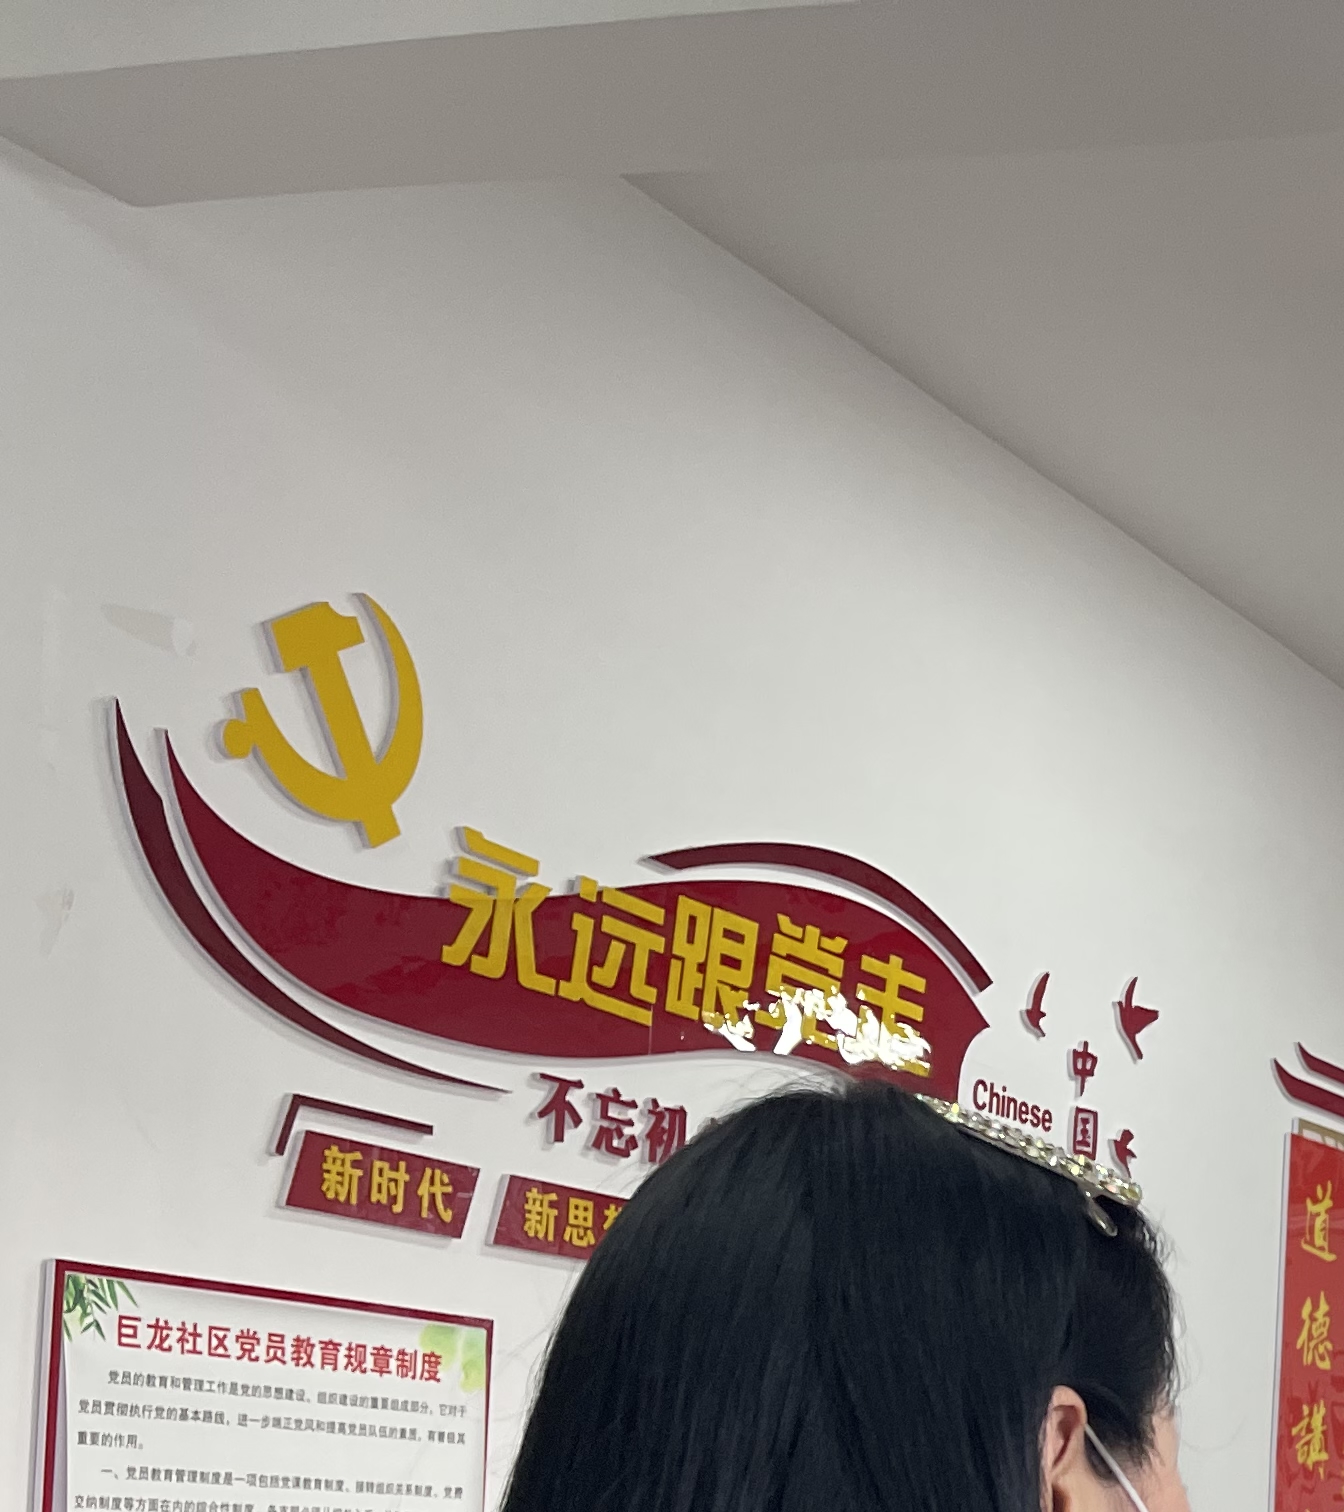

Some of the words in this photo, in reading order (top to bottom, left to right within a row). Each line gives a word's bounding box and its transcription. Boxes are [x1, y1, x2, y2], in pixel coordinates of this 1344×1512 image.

[437, 827, 933, 1078] 永远跟党走
[973, 1079, 1053, 1132] Chinese
[1071, 1041, 1099, 1161] 中国
[321, 1144, 454, 1224] 新时代
[116, 1314, 443, 1383] 巨龙社区党员教育规章制度
